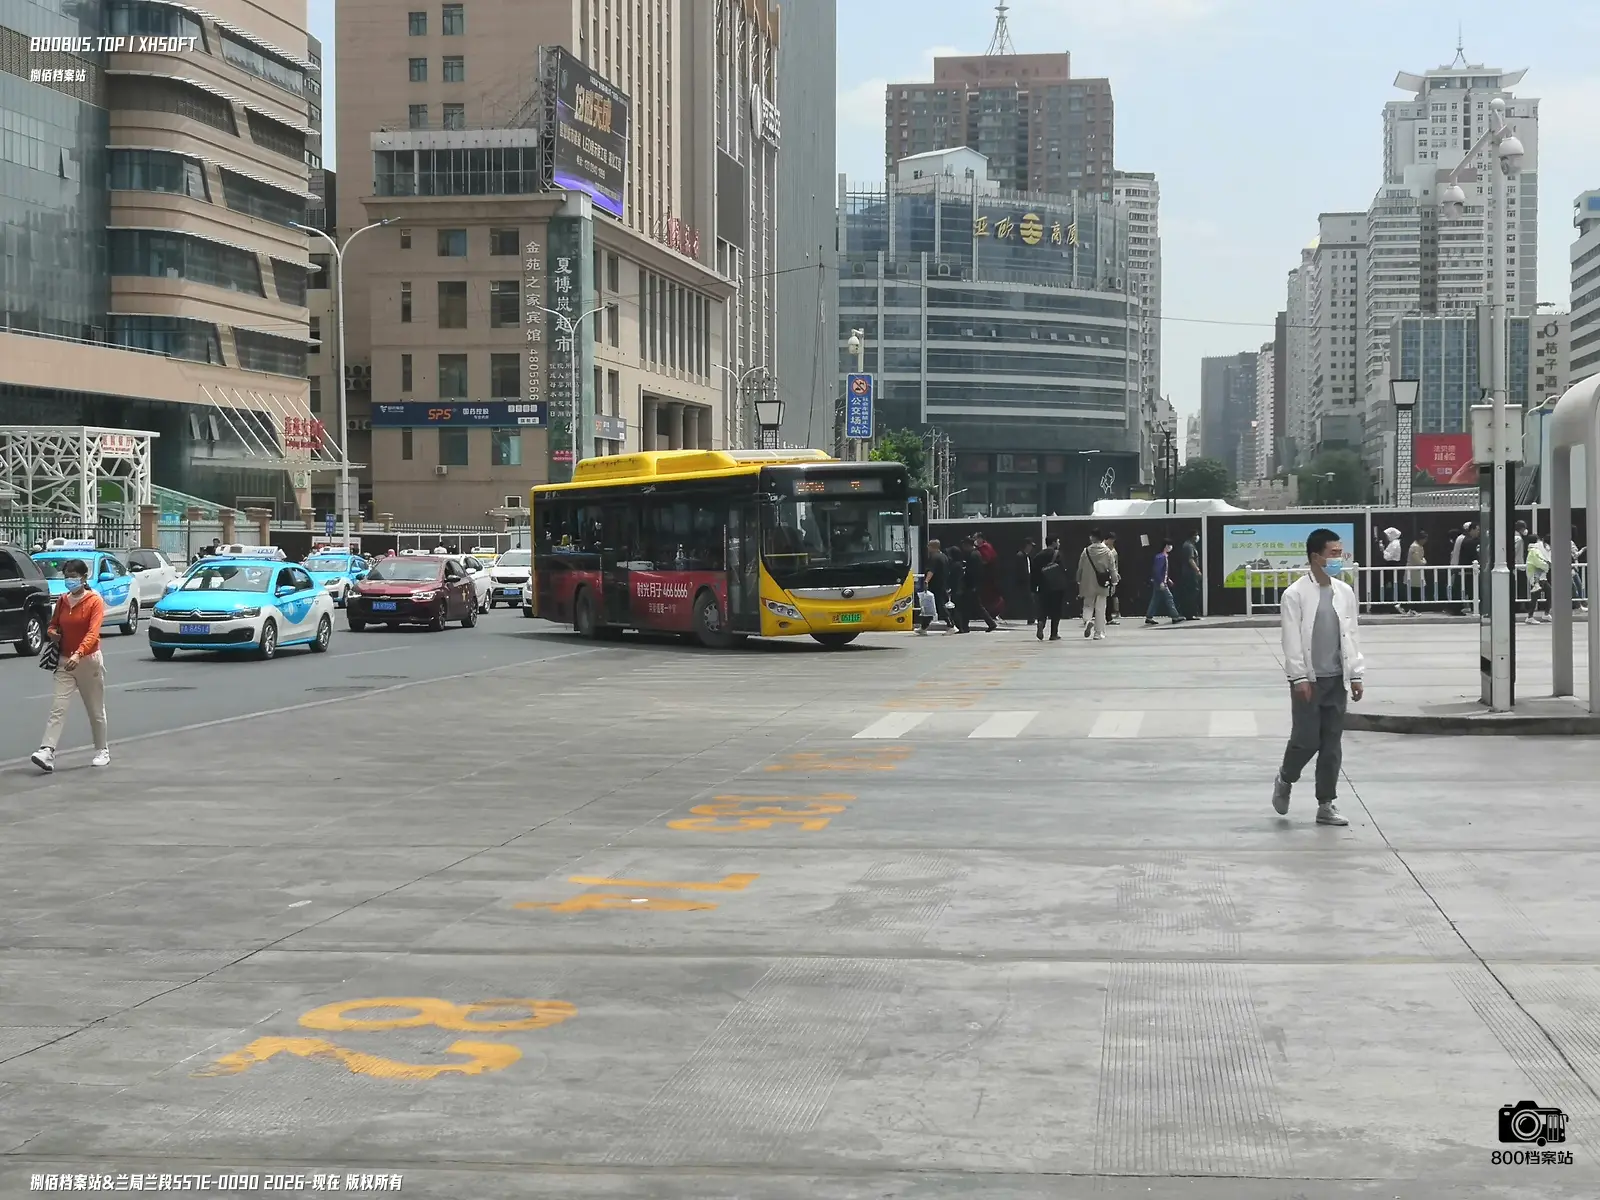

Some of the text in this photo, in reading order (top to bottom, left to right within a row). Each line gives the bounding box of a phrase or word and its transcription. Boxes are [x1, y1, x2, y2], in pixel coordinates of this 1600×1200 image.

[526, 241, 541, 401] 金苑之家宾馆 4805566
[554, 257, 573, 353] 夏博岚超市
[428, 408, 452, 420] SPS
[463, 407, 490, 416] 国药控股
[850, 397, 862, 435] 公交场站
[637, 582, 662, 598] 时光月子
[192, 996, 578, 1079] 82
